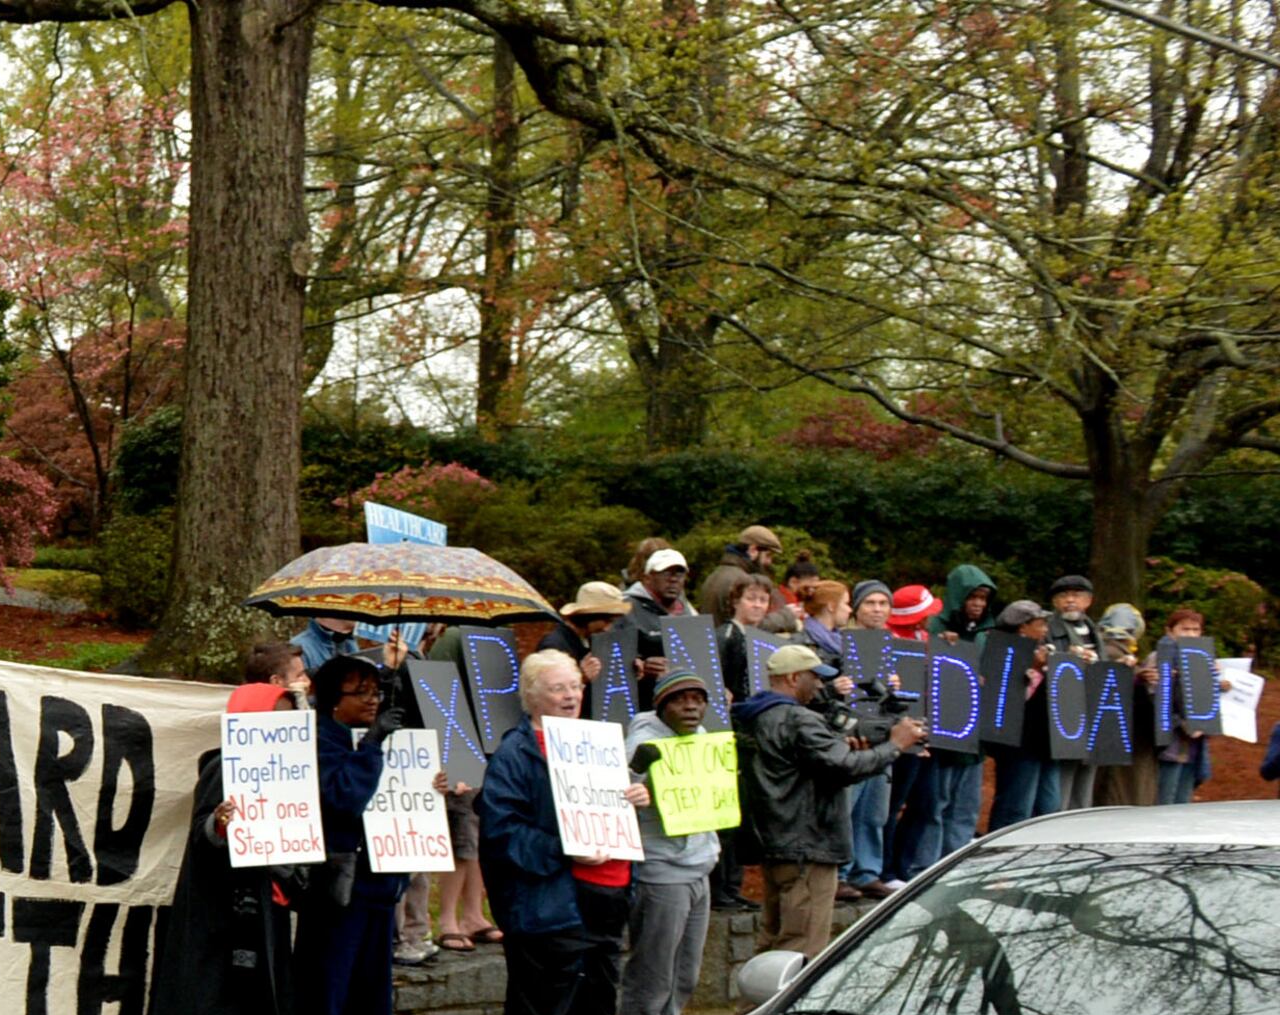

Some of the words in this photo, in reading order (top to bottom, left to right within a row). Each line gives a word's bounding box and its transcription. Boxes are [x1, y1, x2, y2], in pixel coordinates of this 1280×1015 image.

[547, 726, 573, 763] No
[659, 741, 695, 776] NOT
[224, 753, 311, 794] Together
[554, 768, 580, 804] No
[229, 793, 268, 821] Not
[276, 802, 309, 820] one
[233, 827, 275, 865] Step
[372, 817, 449, 871] politics
